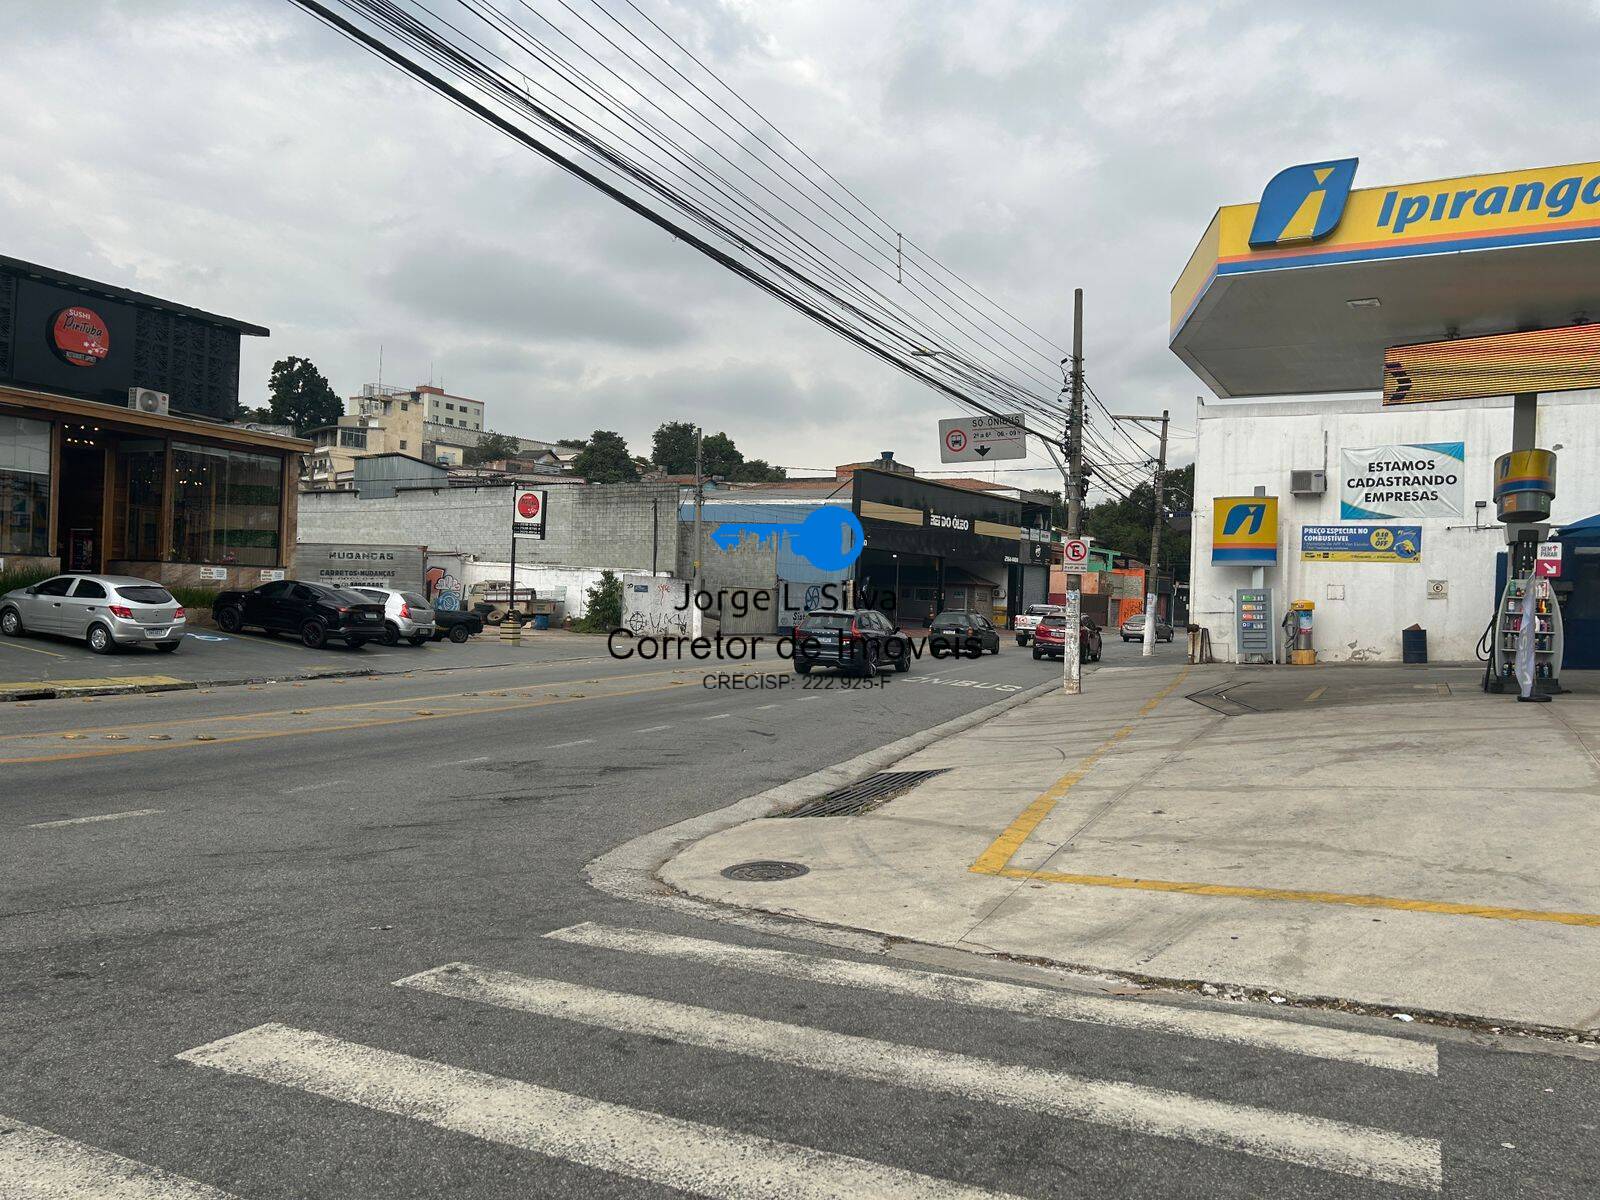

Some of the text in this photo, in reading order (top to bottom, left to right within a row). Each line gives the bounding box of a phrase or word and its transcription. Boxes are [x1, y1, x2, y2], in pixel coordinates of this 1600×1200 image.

[70, 309, 91, 320] SUSHI
[972, 417, 984, 427] SÓ
[1368, 459, 1435, 473] ESTAMOS
[1347, 474, 1457, 489] CADASTRANDO
[1364, 490, 1439, 503] EMPRESAS
[941, 516, 952, 528] DO
[952, 514, 969, 531] ÓLEO
[1303, 527, 1369, 536] PREÇO ESPECIAL NO
[1303, 534, 1349, 542] COMBUSTÍVEL
